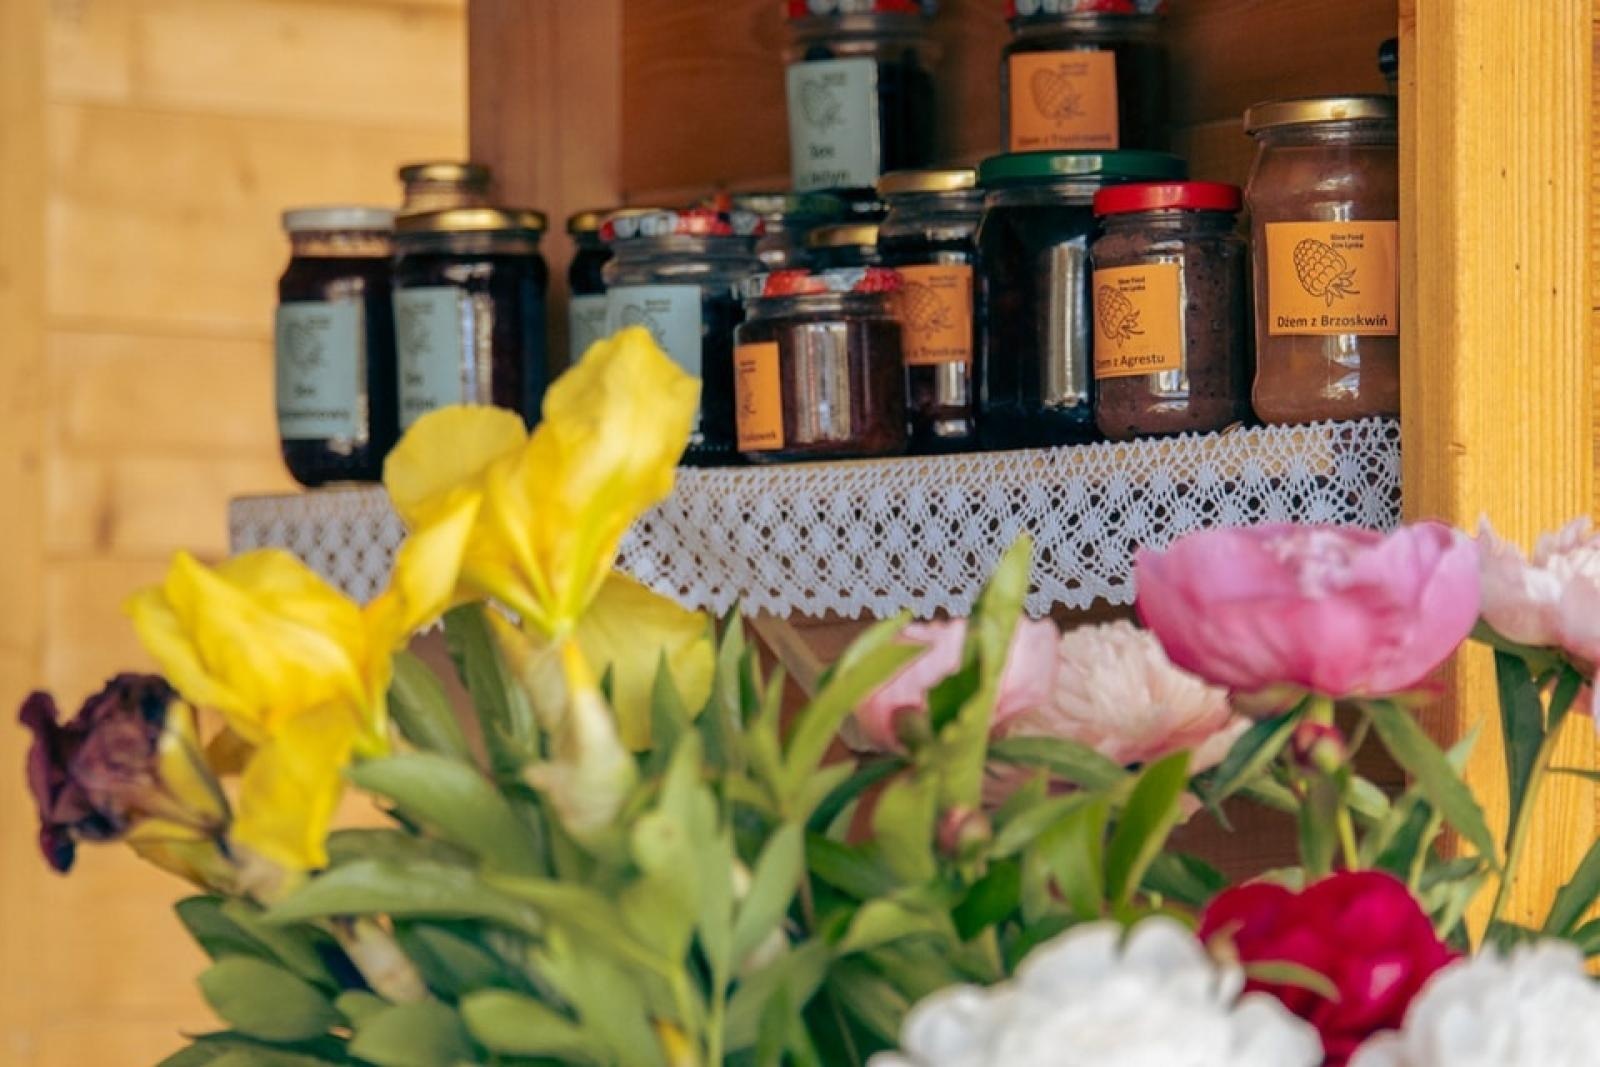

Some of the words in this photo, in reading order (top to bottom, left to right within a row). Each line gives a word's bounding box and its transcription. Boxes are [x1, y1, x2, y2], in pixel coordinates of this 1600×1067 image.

[1277, 315, 1308, 328] Dżem
[1311, 317, 1317, 328] z
[1321, 313, 1388, 327] Brzoskwiń
[1113, 357, 1118, 368] z
[1120, 354, 1165, 369] Agrestu
